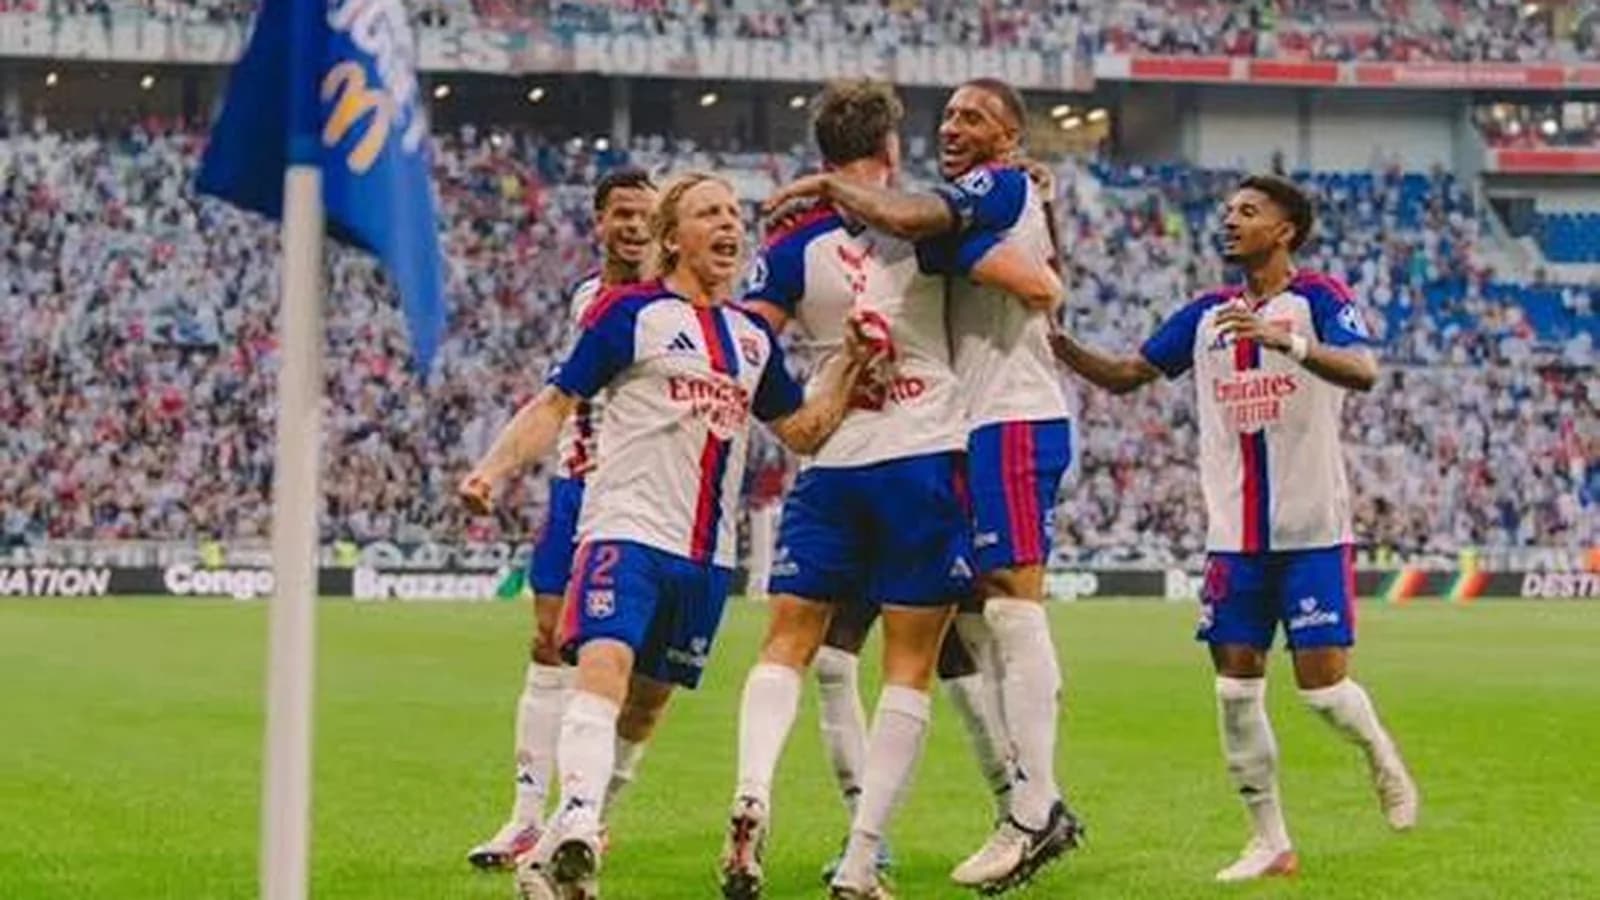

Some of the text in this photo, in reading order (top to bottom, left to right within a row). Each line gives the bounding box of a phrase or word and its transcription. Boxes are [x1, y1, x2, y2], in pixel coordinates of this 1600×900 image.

[164, 564, 275, 600] Congo
[590, 545, 621, 586] 2
[1165, 567, 1204, 602] Br
